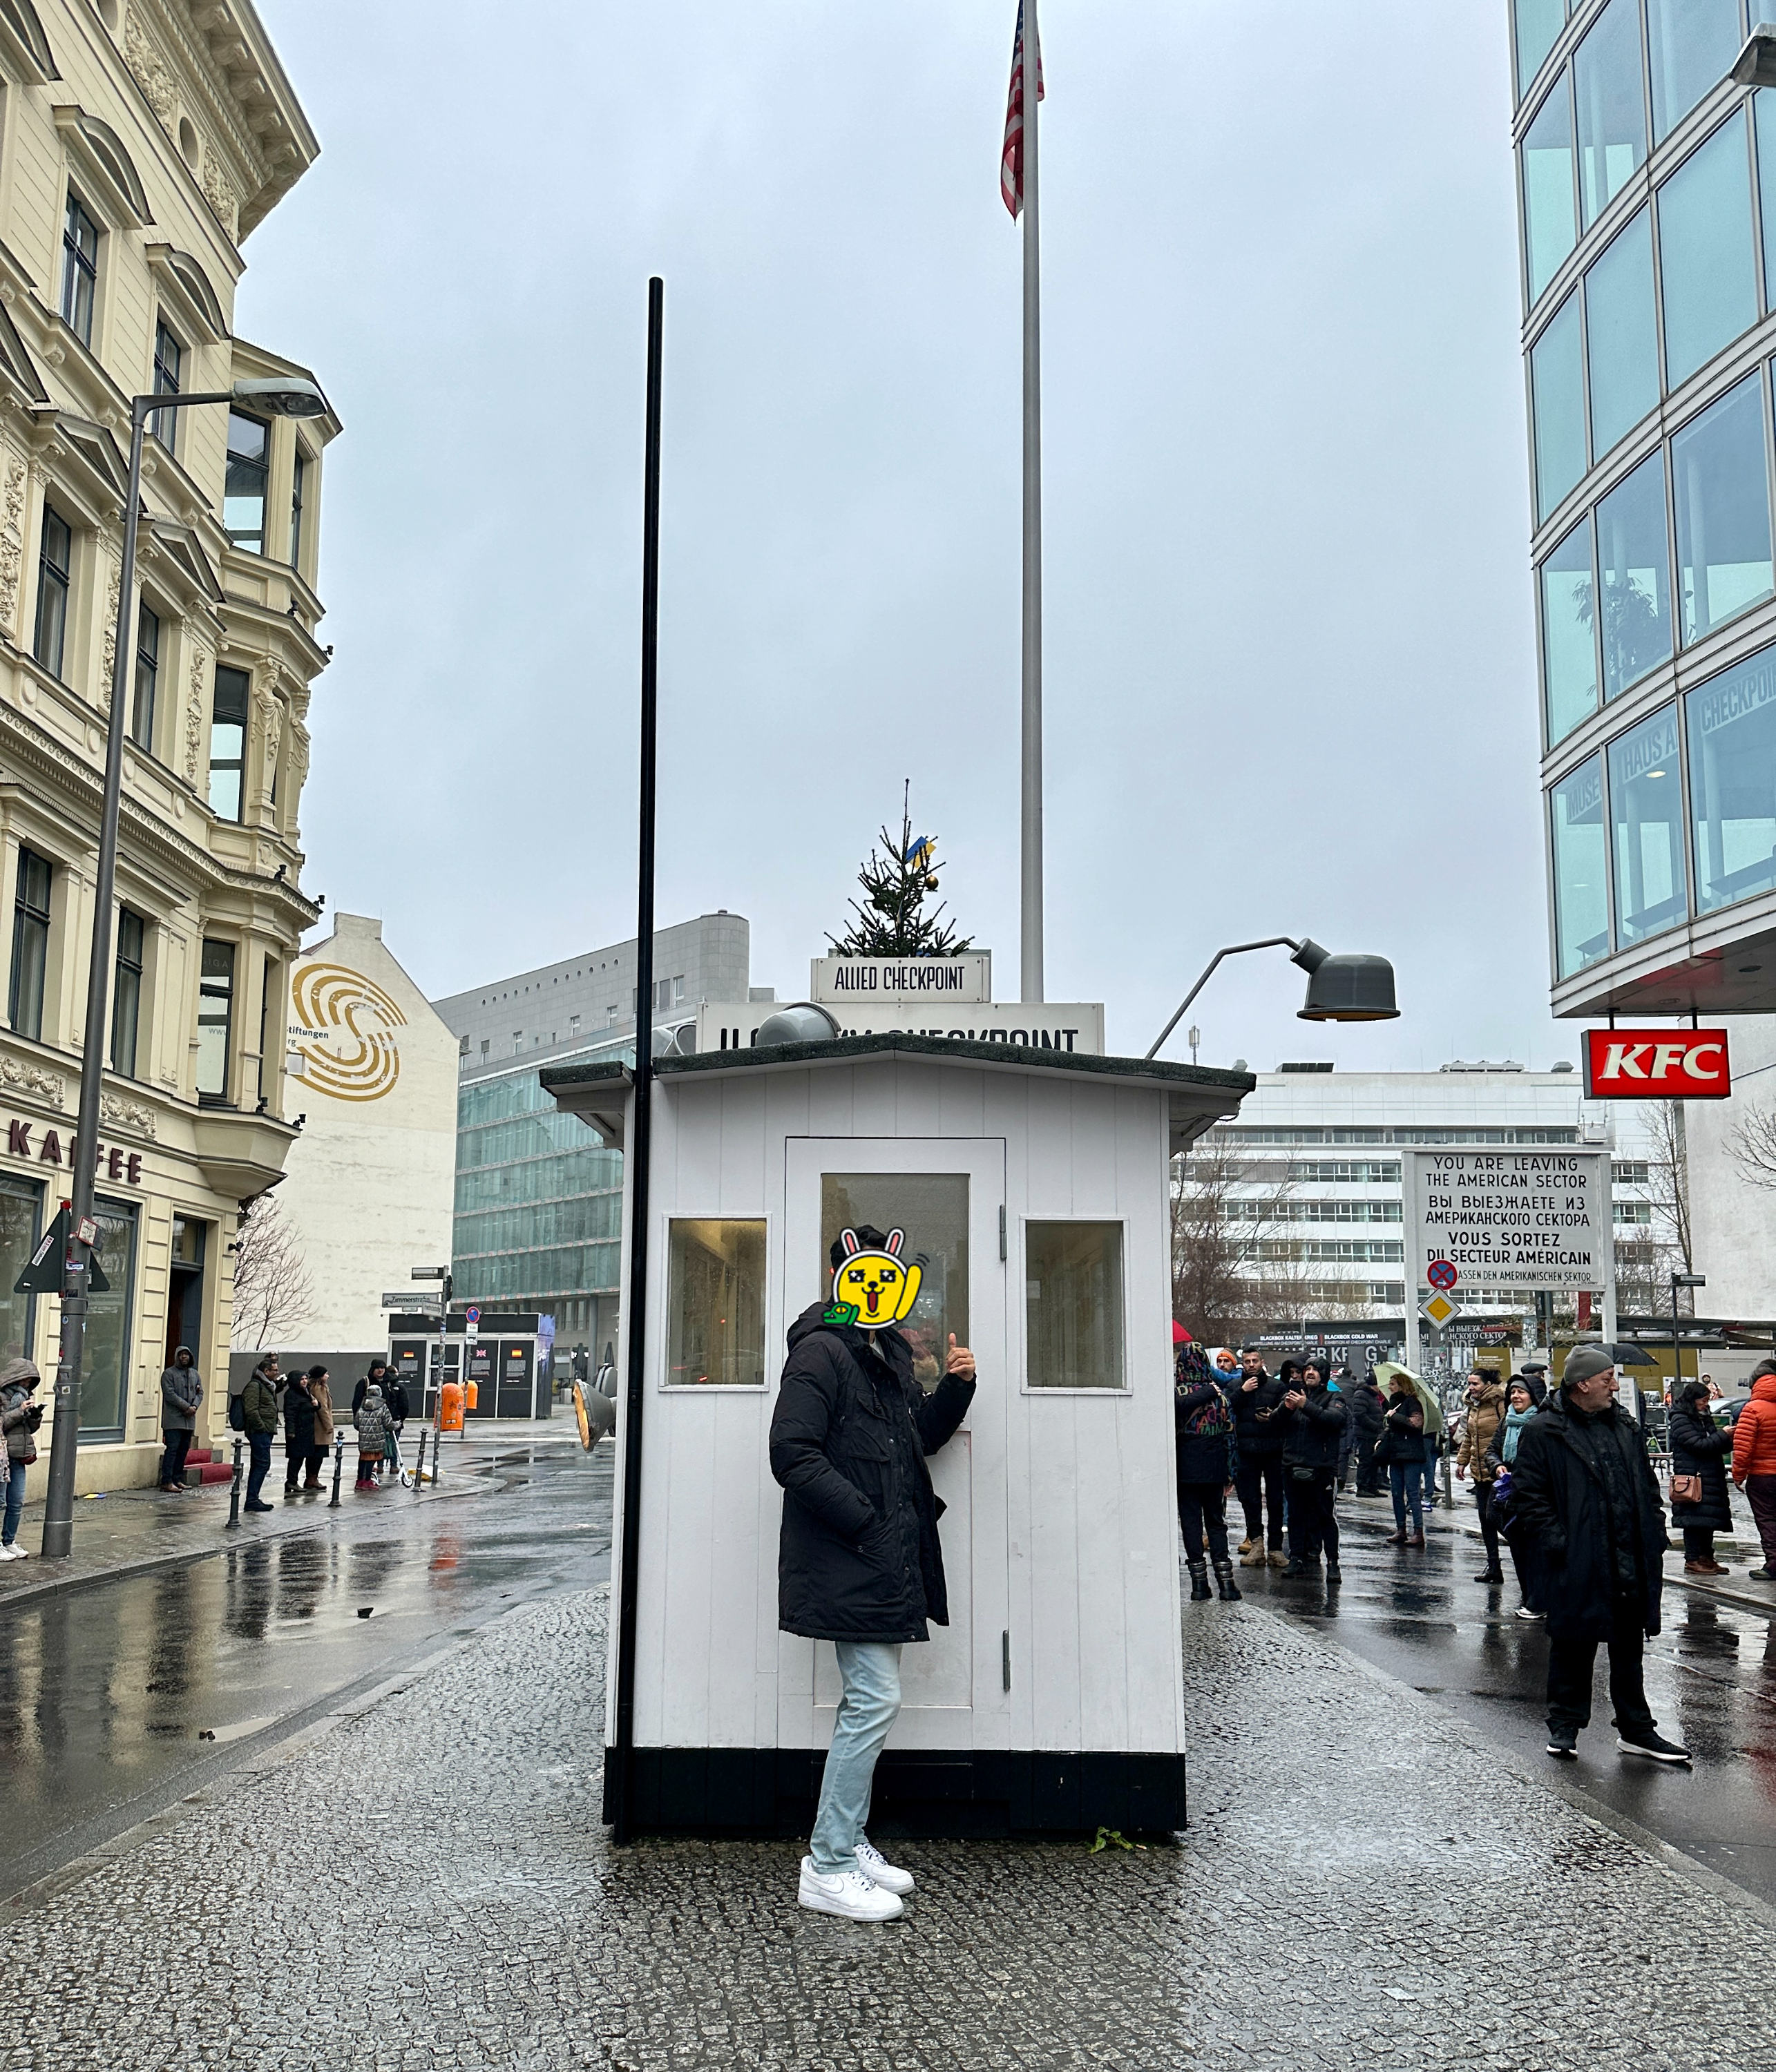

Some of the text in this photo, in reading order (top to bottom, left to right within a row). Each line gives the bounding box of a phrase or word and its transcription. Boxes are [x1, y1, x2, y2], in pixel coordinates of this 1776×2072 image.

[1569, 770, 1602, 820] MUSE
[1623, 730, 1662, 780] HAUS
[1665, 720, 1678, 755] A
[834, 966, 965, 990] ALLIED CHECKPOINT
[287, 1026, 329, 1039] tiftungen
[1598, 1044, 1722, 1080] KFC
[1433, 1156, 1578, 1171] YOU ARE LEAVING
[1426, 1173, 1587, 1189] THE AMERICAN SECTOR
[1429, 1195, 1585, 1210] ВЫ ВЫЕЗЖАЕТЕ ИЗ
[1425, 1211, 1590, 1227] АМЕРИКАНСКОГО СЕКТОРА
[1448, 1231, 1560, 1247] VOUS SORTEZ
[1427, 1249, 1444, 1262] DU
[1450, 1249, 1510, 1263] SECTEUR
[1458, 1270, 1591, 1282] ASSEN DEN AMERIKANISCHEN SEKTOR
